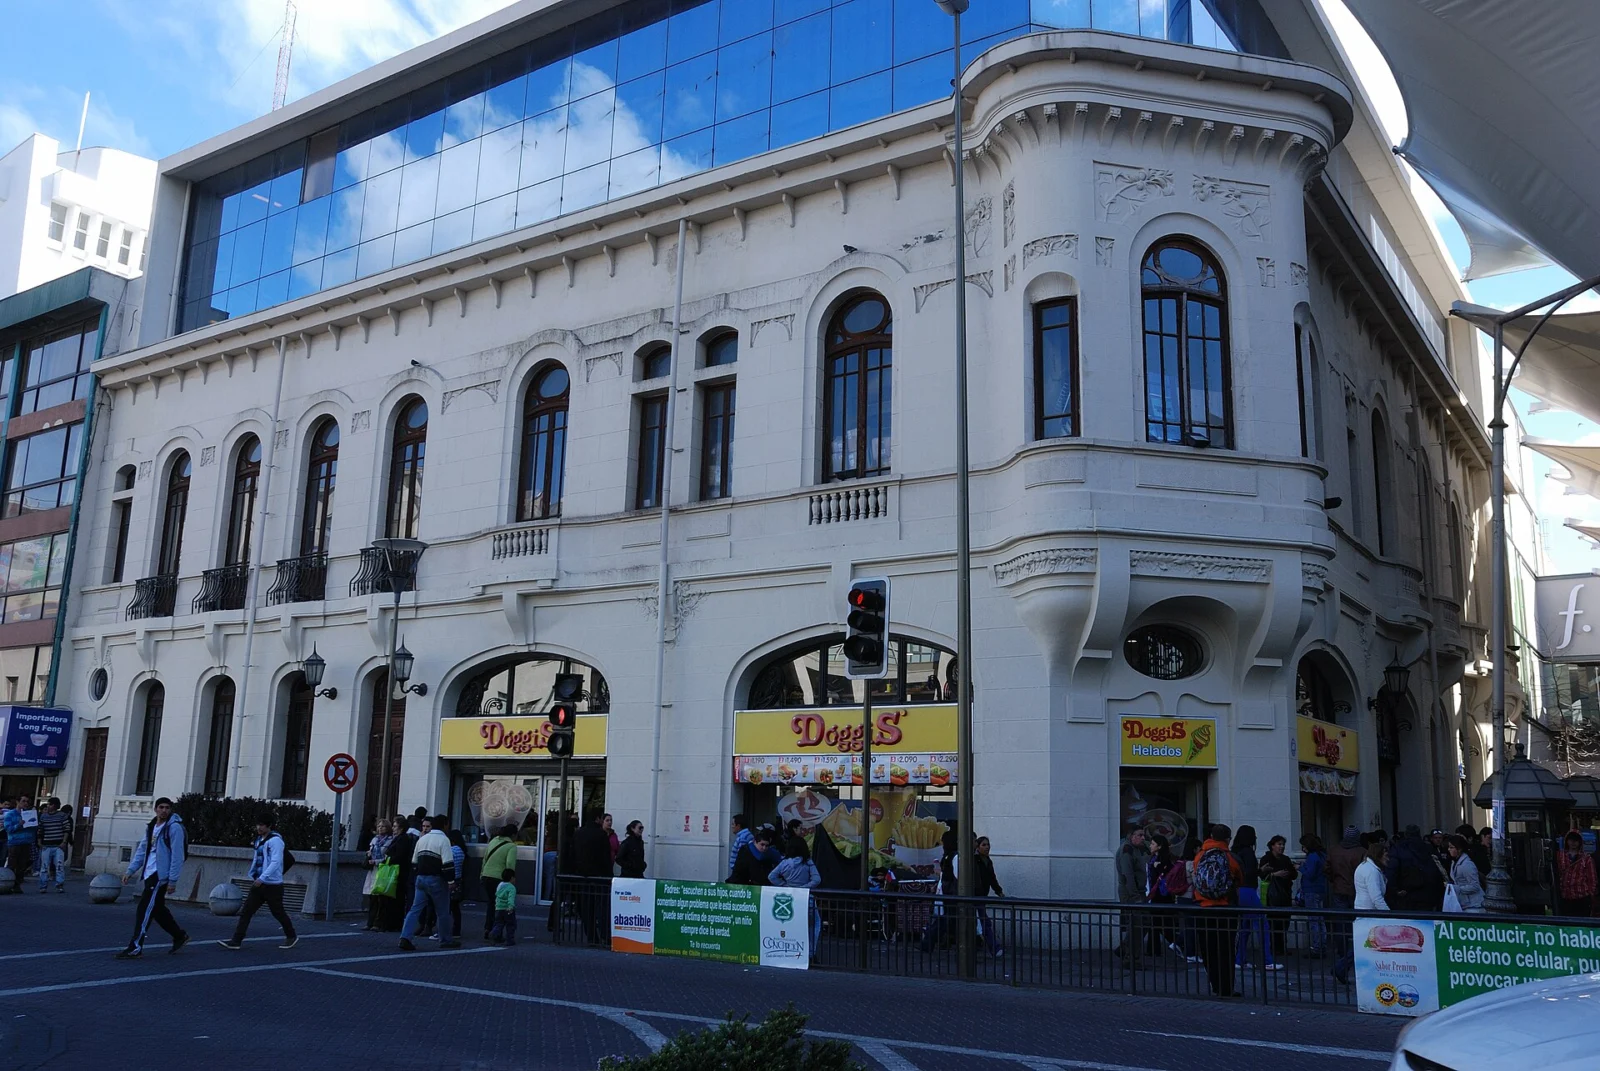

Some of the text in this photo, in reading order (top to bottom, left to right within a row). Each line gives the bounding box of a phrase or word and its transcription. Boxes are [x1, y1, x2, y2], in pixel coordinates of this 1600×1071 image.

[16, 712, 68, 723] Importadora
[18, 722, 62, 734] Long Feng
[1123, 720, 1187, 742] DoggiS
[1132, 744, 1182, 757] Helados
[664, 884, 680, 894] Padres:
[729, 888, 746, 898] cuando
[657, 898, 676, 906] comenten
[689, 899, 709, 910] problema
[710, 902, 718, 911] que
[718, 901, 722, 910] le
[732, 902, 758, 914] sucediendo,
[614, 914, 652, 927] abastible
[701, 912, 707, 922] de
[680, 924, 730, 937] siempre dice la verdad.
[1438, 922, 1454, 940] Al
[1458, 924, 1530, 947] conducir,
[1534, 931, 1554, 946] no
[701, 942, 720, 950] recuerda
[1448, 946, 1511, 966] teléfono
[1516, 950, 1574, 973] celular,
[1392, 961, 1418, 974] Premium
[1450, 971, 1518, 988] provocar
